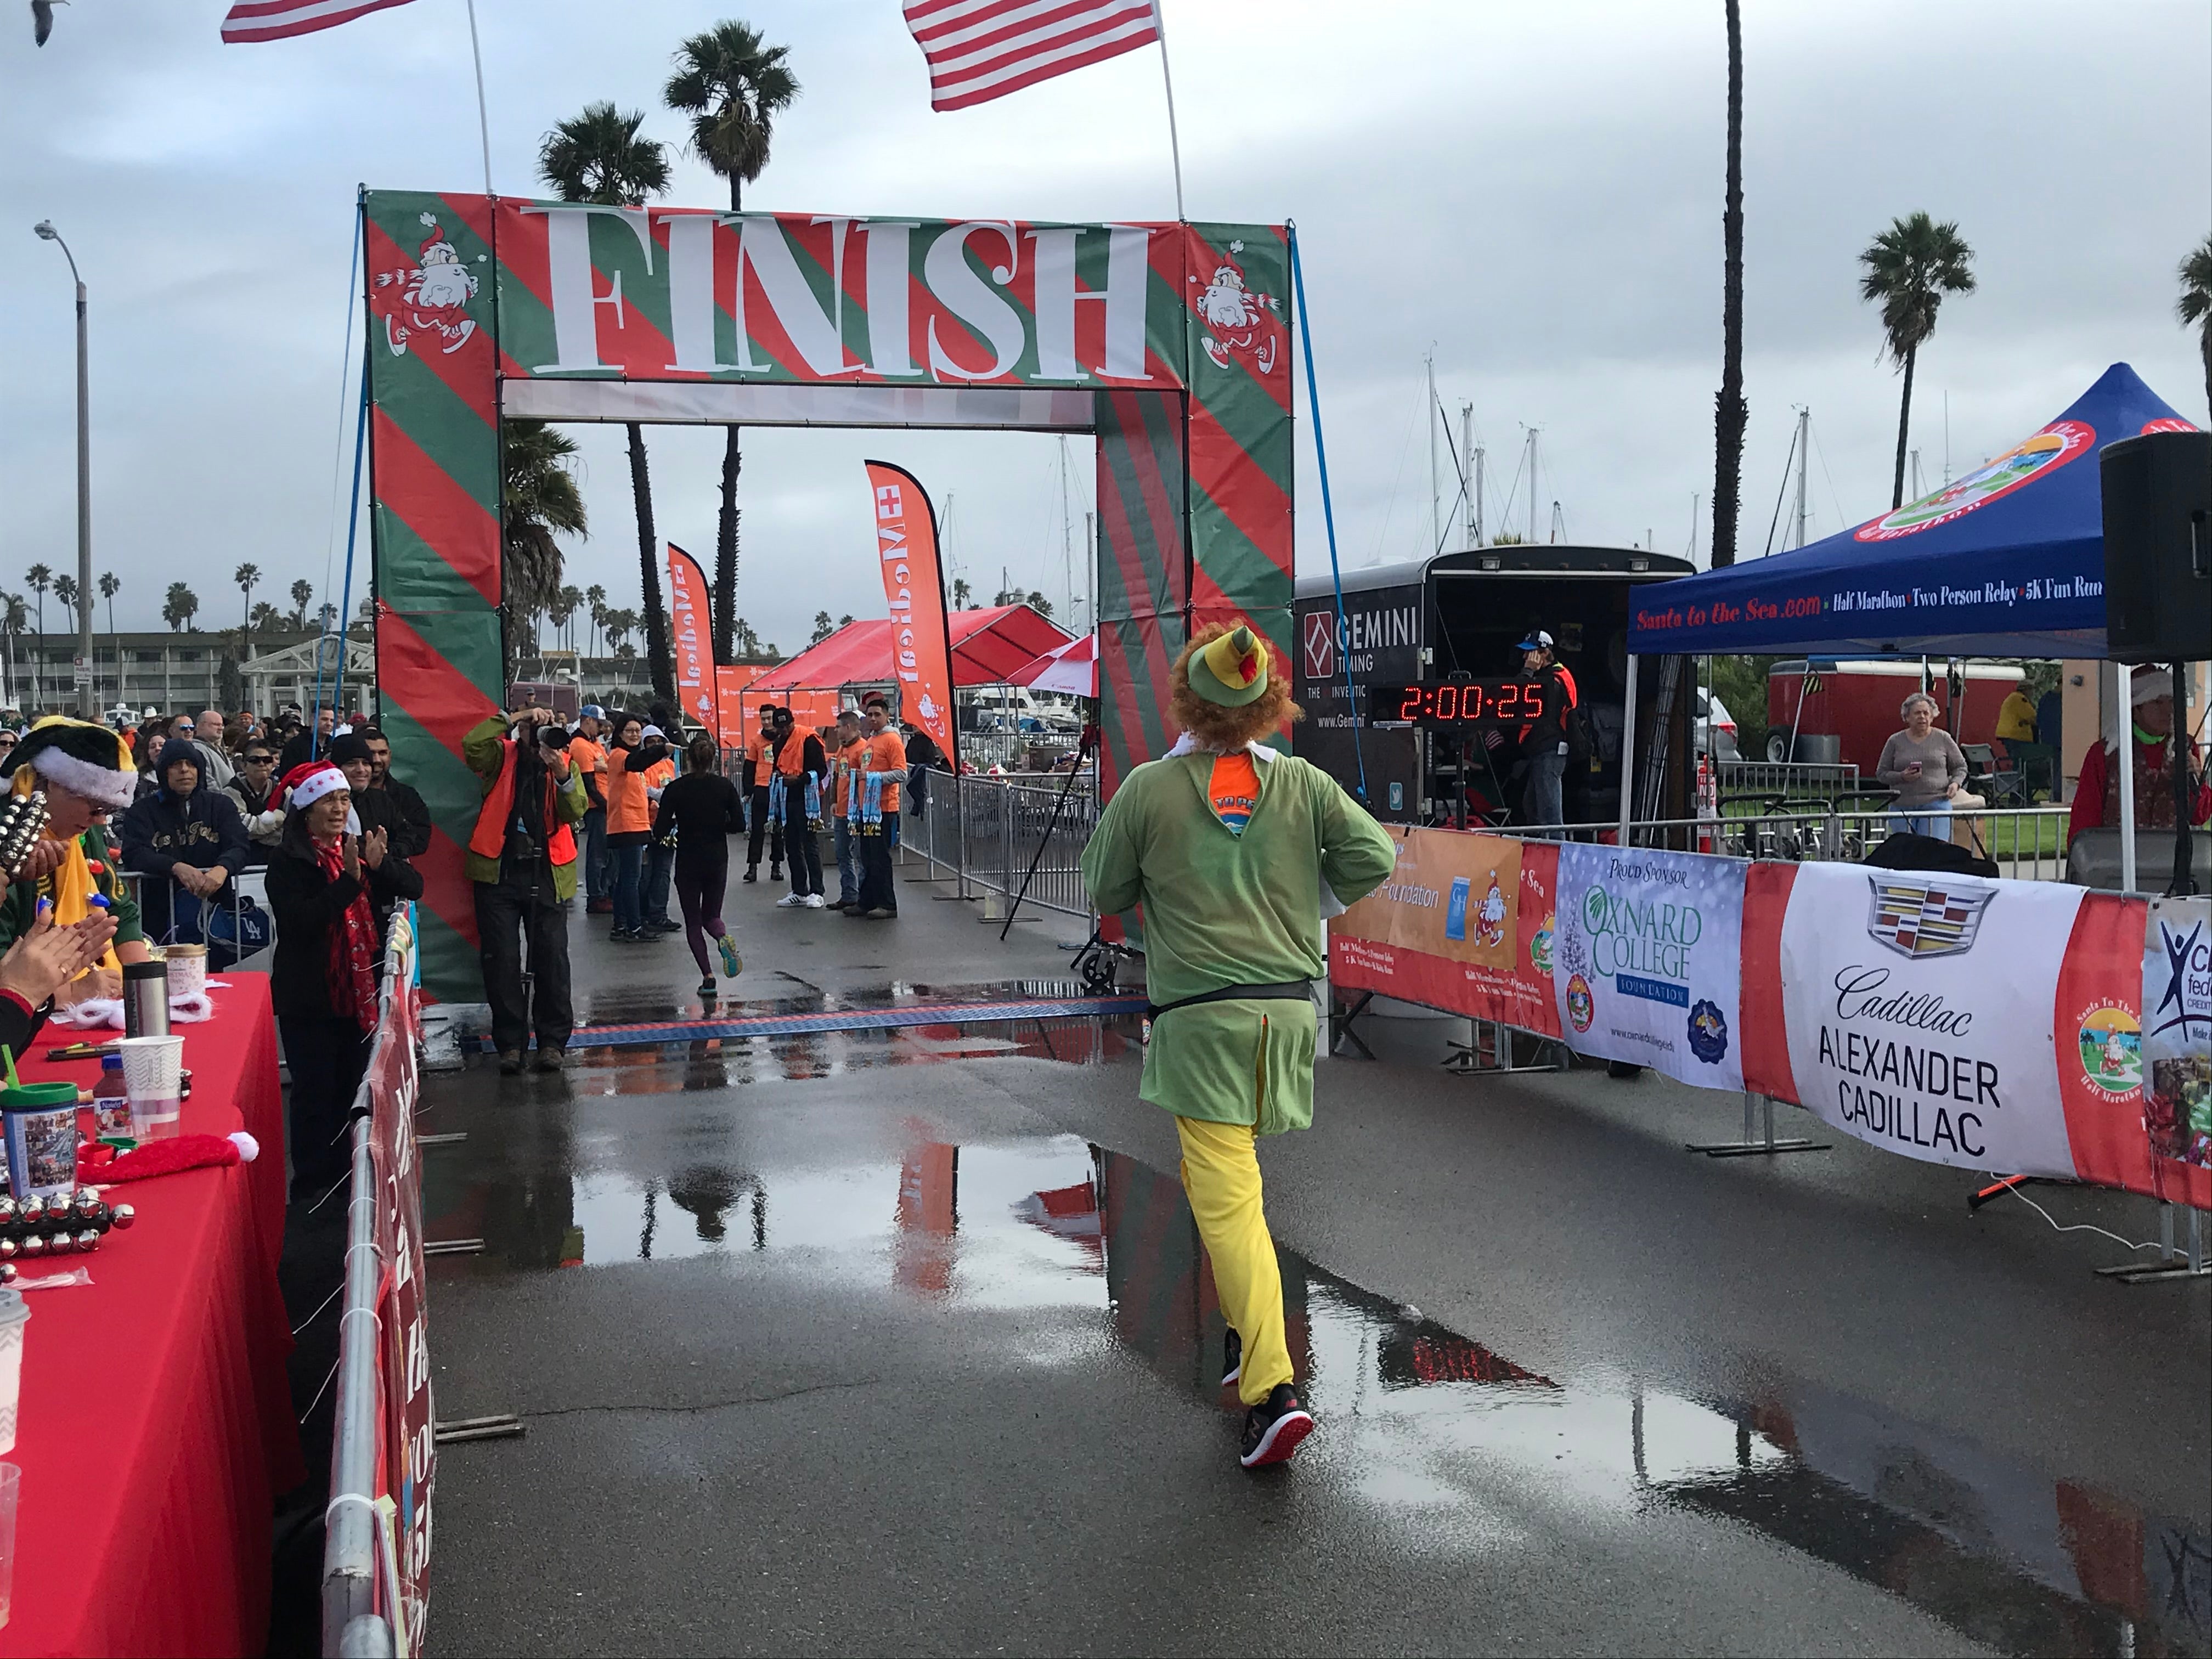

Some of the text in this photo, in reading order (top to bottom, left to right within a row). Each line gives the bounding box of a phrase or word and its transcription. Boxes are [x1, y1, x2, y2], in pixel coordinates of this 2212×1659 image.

[520, 206, 1156, 382] FINISH
[1833, 575, 2103, 611] Half Marathon Two Person Relay 5K Fun Run
[1336, 607, 1416, 651] GEMINI
[1637, 607, 1682, 631] Santa
[1687, 606, 1706, 627] to
[1712, 602, 1740, 624] the
[1308, 687, 1320, 699] THE
[1318, 714, 1365, 729] www.Gemni
[1528, 869, 1545, 899] Sea
[1609, 856, 1691, 889] PROUD SPONSOR
[1379, 877, 1438, 909] Foundation
[1583, 884, 1702, 946] OXNARD
[1593, 928, 1691, 981] COLLEGE
[1621, 979, 1684, 1002] FOUNDATION
[1835, 964, 1973, 1037] Cadillac
[2188, 974, 2212, 997] fed
[2076, 996, 2134, 1024] Santa To The
[1819, 1025, 2001, 1109] ALEXANDER
[2102, 1088, 2142, 1104] Maratho
[1838, 1079, 1985, 1158] CADILLAC
